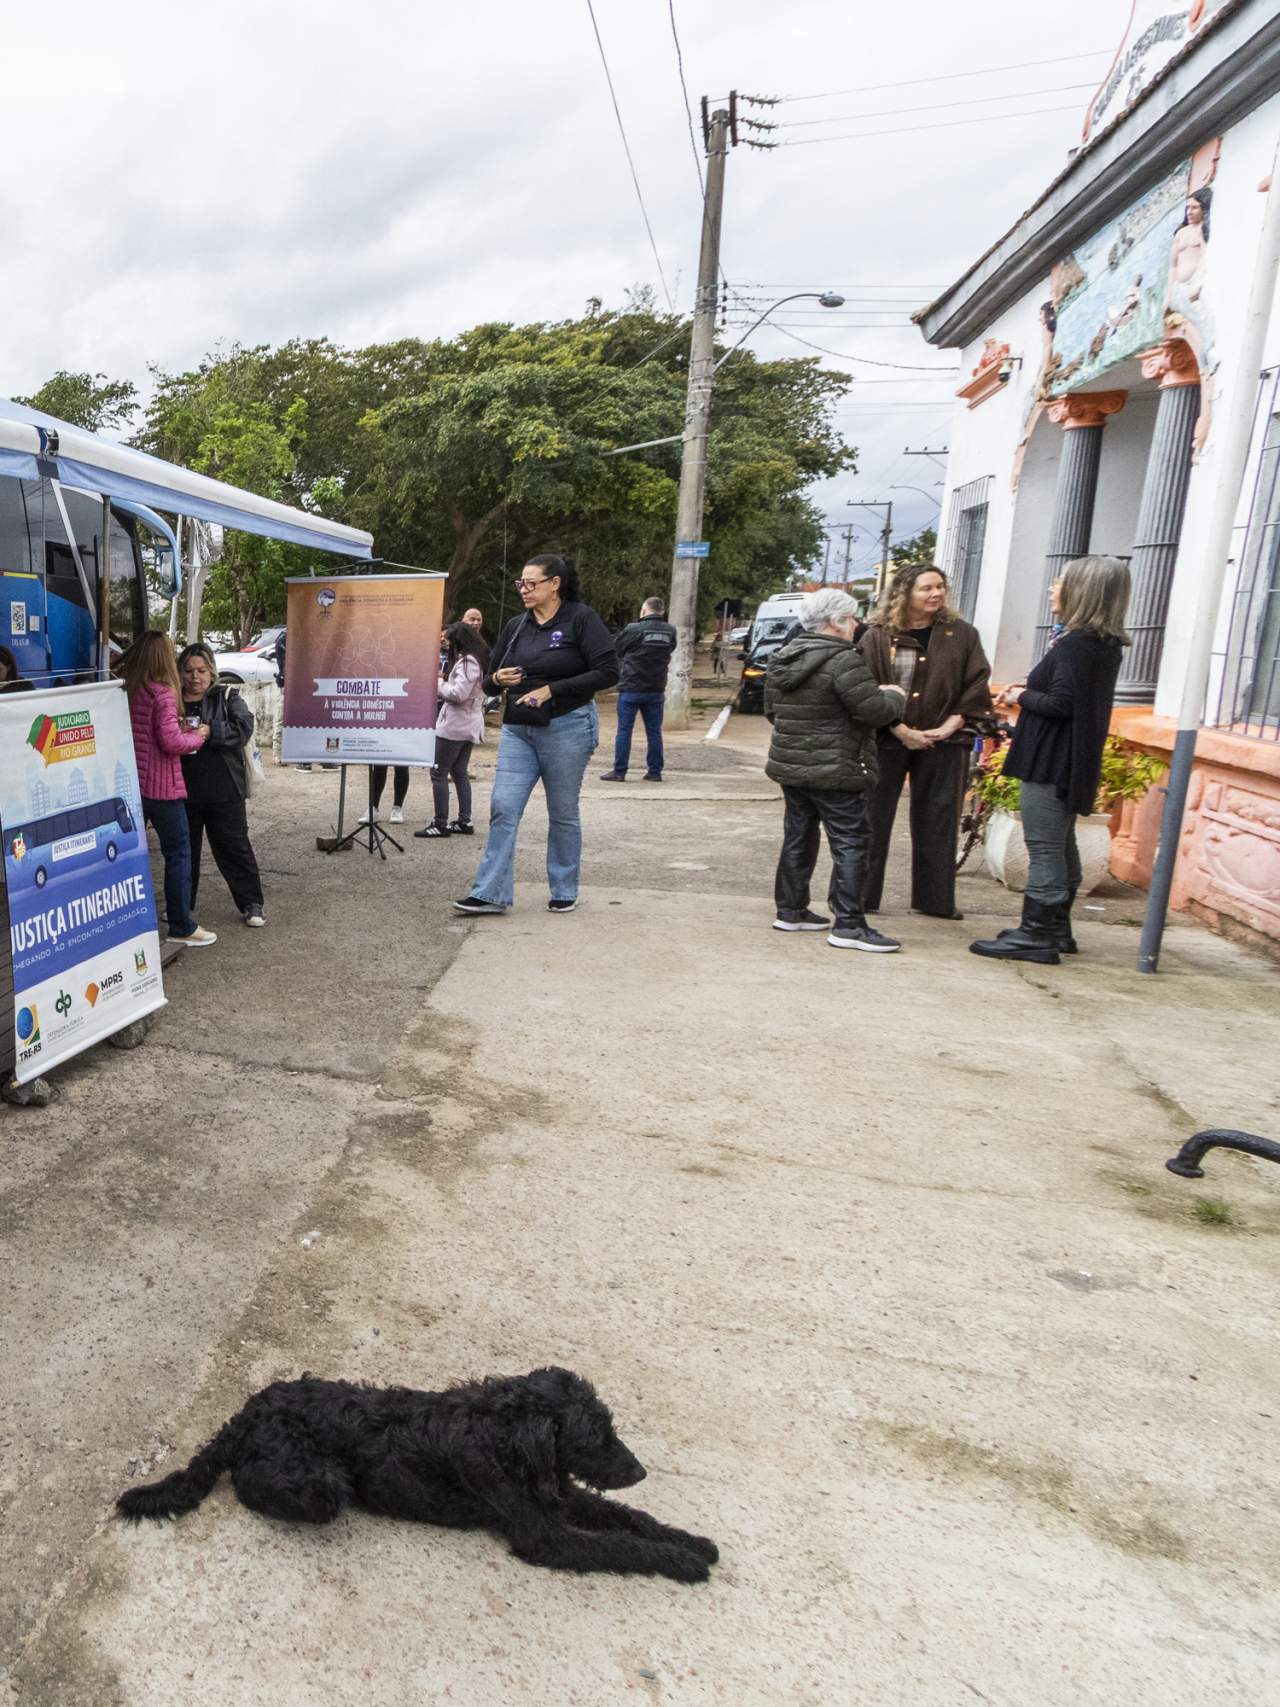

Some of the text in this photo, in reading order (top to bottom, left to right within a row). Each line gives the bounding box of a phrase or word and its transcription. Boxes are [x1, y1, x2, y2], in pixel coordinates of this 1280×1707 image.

[336, 680, 381, 696] COMBATE
[362, 698, 395, 710] DOMÉSTICA
[331, 710, 387, 721] CONTRA A MULHER
[59, 727, 94, 743] UNIDO PELO
[10, 874, 146, 956] JUSTIÇA ITINERANTE
[54, 943, 65, 953] AO
[68, 926, 104, 947] ENCONTRO
[100, 971, 124, 991] MPRS
